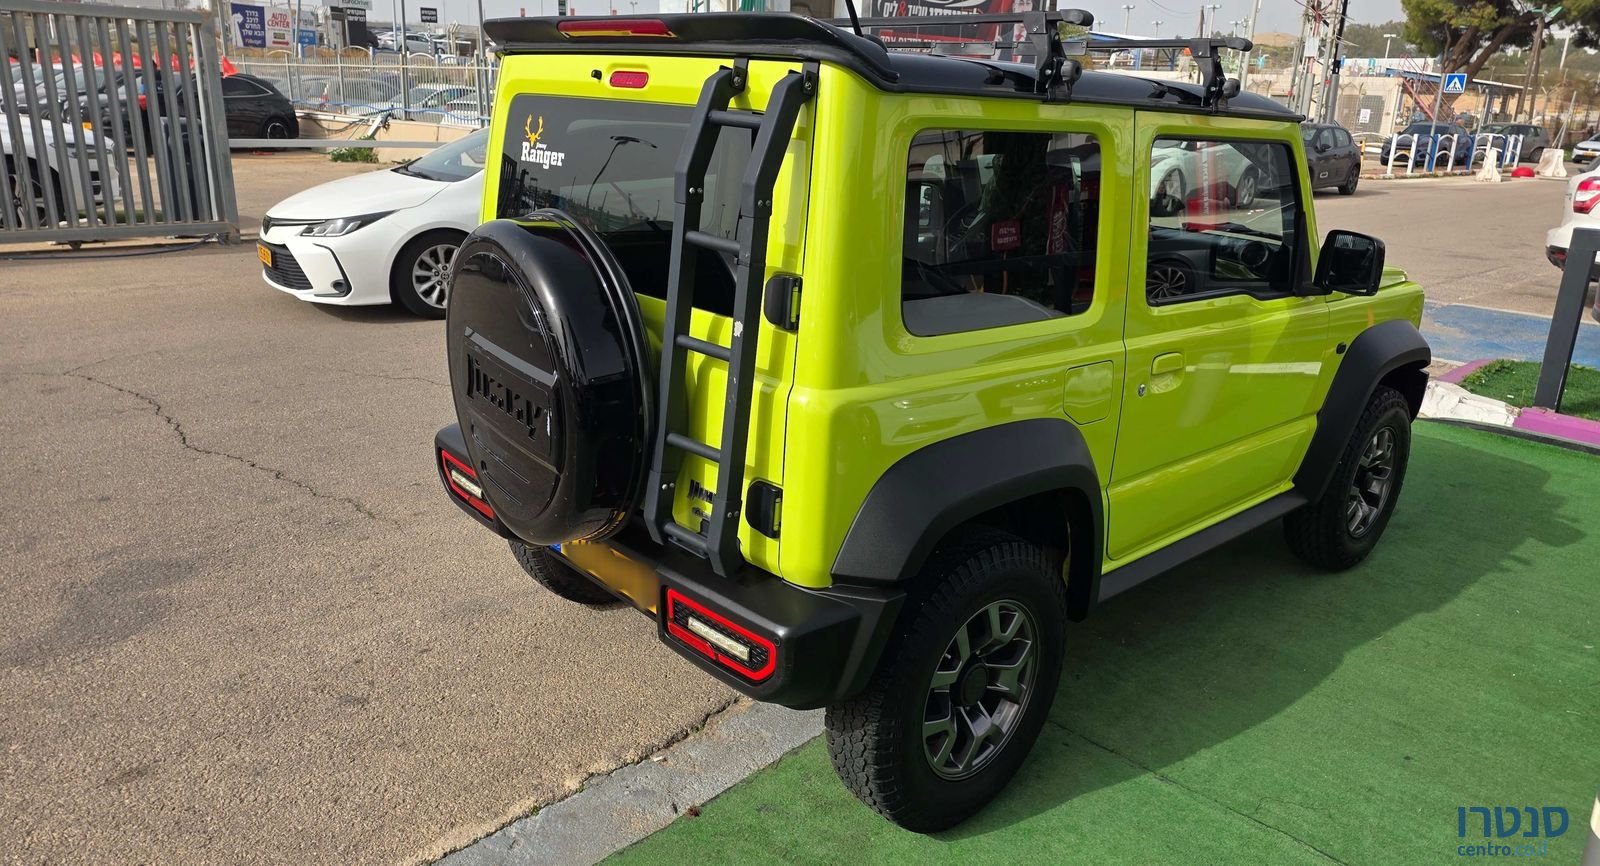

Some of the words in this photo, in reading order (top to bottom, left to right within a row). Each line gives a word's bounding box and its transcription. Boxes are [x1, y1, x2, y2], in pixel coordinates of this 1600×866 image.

[272, 12, 288, 21] AUTO
[267, 20, 290, 29] CENTER
[520, 141, 565, 170] Ranger
